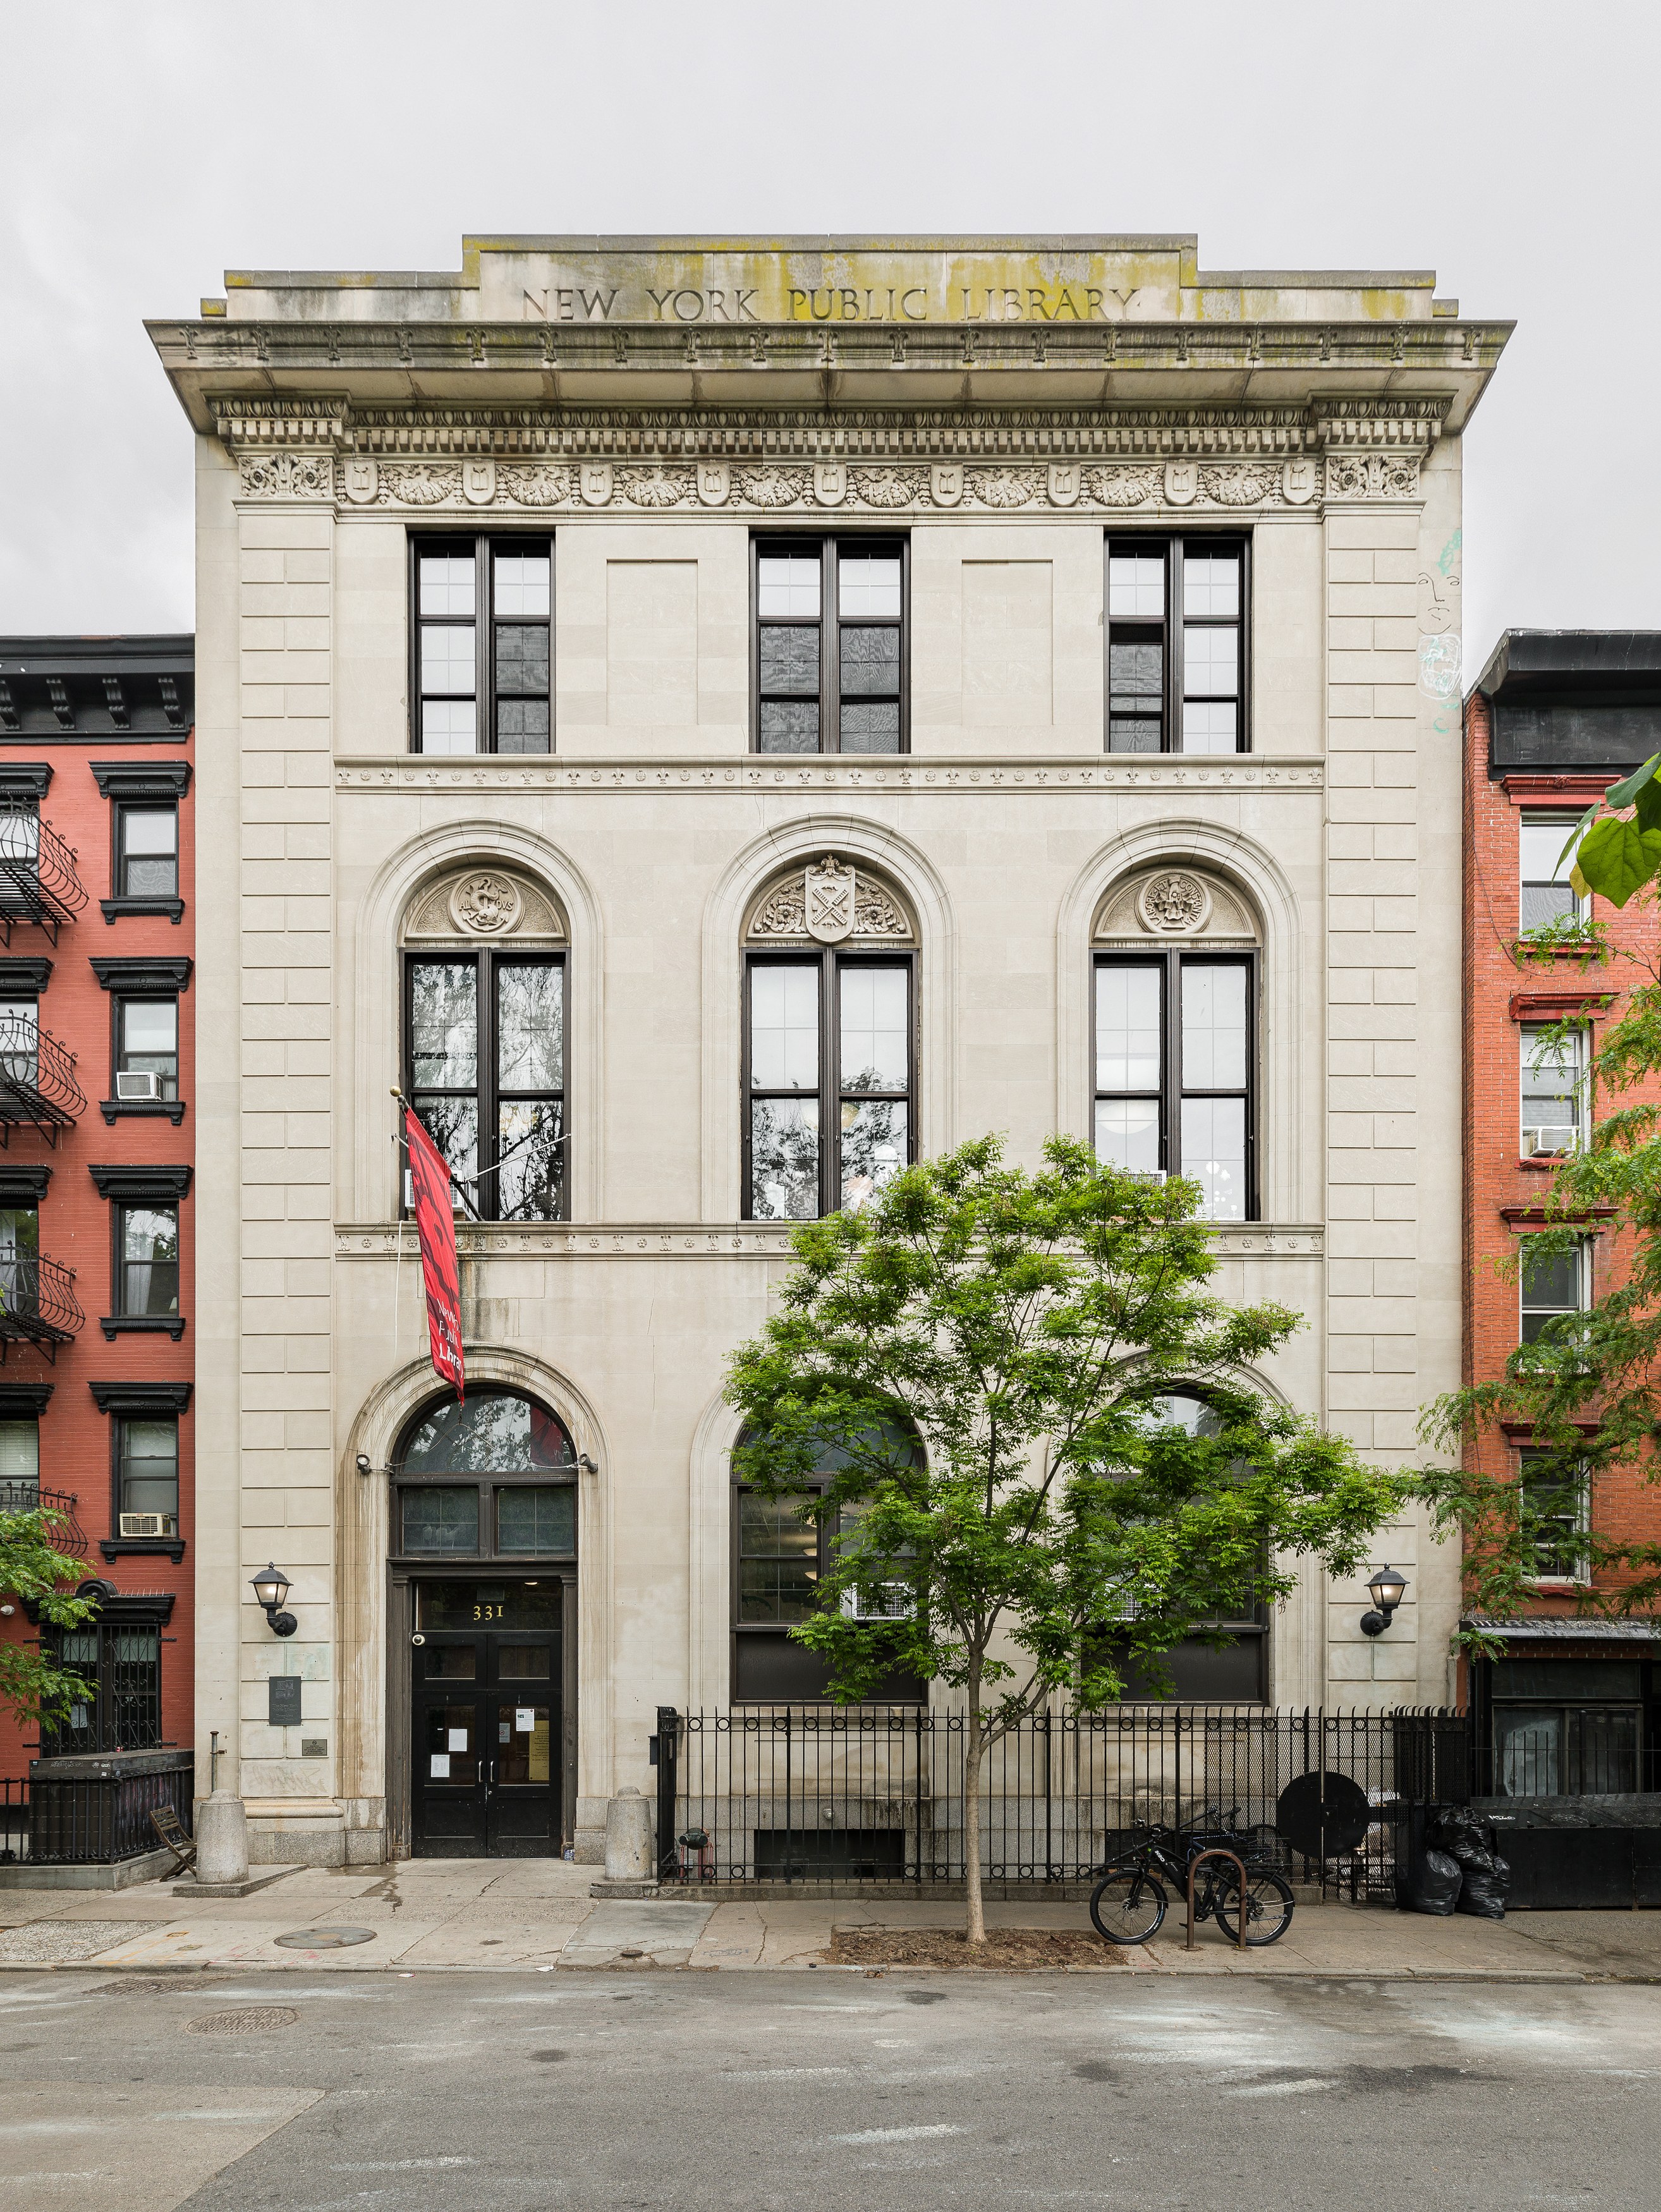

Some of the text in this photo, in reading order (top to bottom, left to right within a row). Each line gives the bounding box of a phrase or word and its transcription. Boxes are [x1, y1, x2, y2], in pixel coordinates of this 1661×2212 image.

[523, 288, 1140, 321] NEW YORK PUBLIC LIBRARY
[1179, 880, 1202, 926] CONSTANTIA
[473, 1605, 504, 1620] 331
